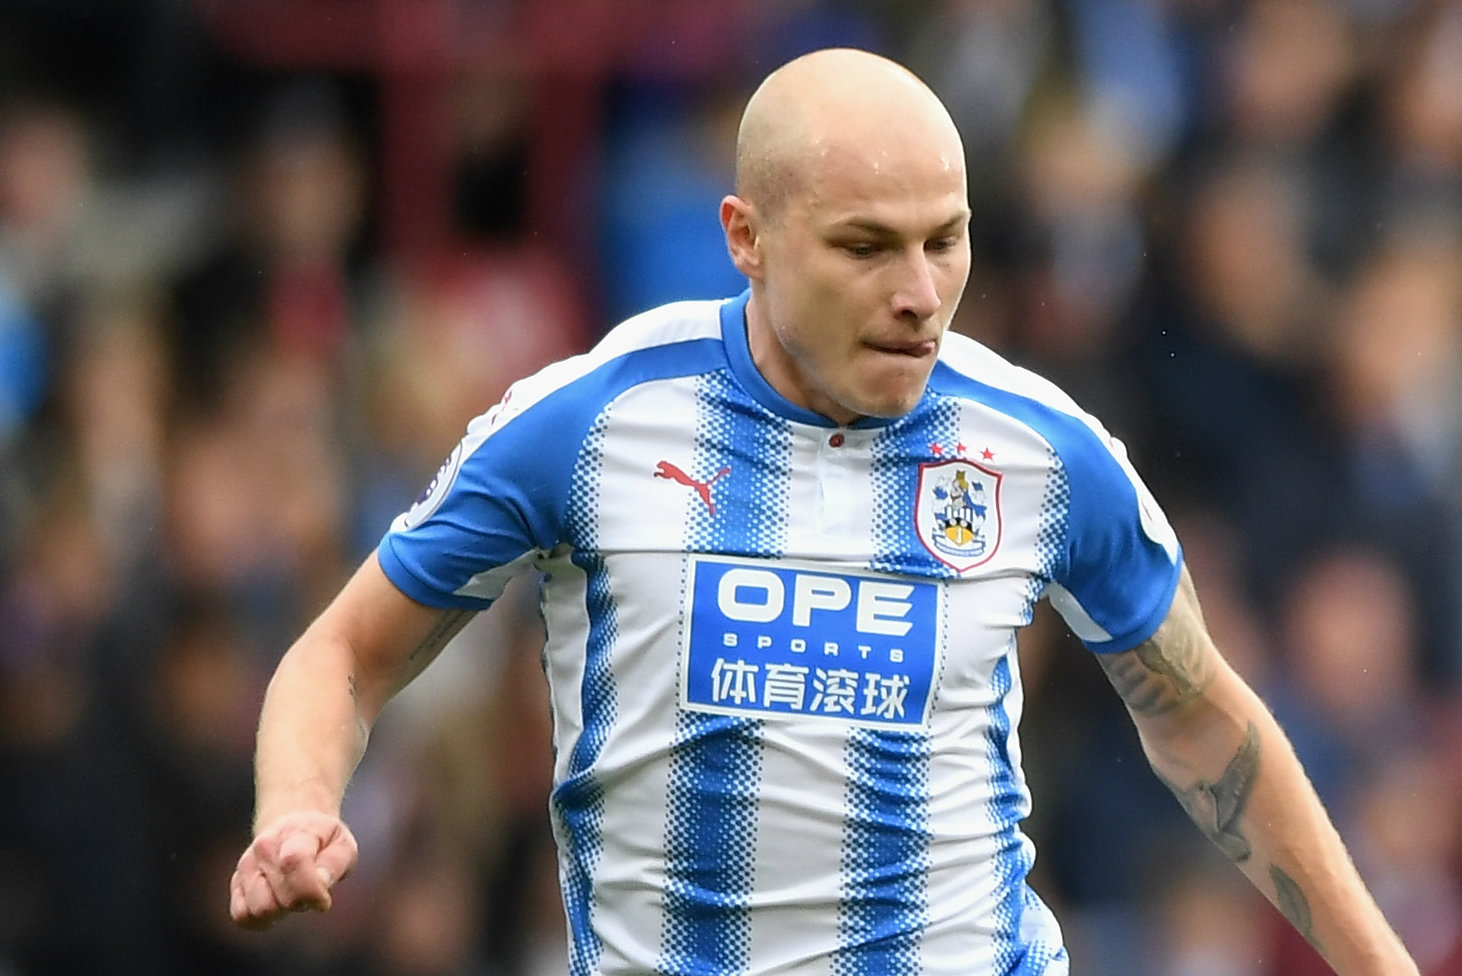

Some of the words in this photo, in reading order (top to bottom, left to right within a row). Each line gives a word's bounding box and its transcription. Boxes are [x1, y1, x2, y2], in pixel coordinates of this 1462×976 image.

[717, 567, 915, 637] OPE
[723, 632, 904, 664] SPORTS
[711, 657, 911, 720] 体育滚球
